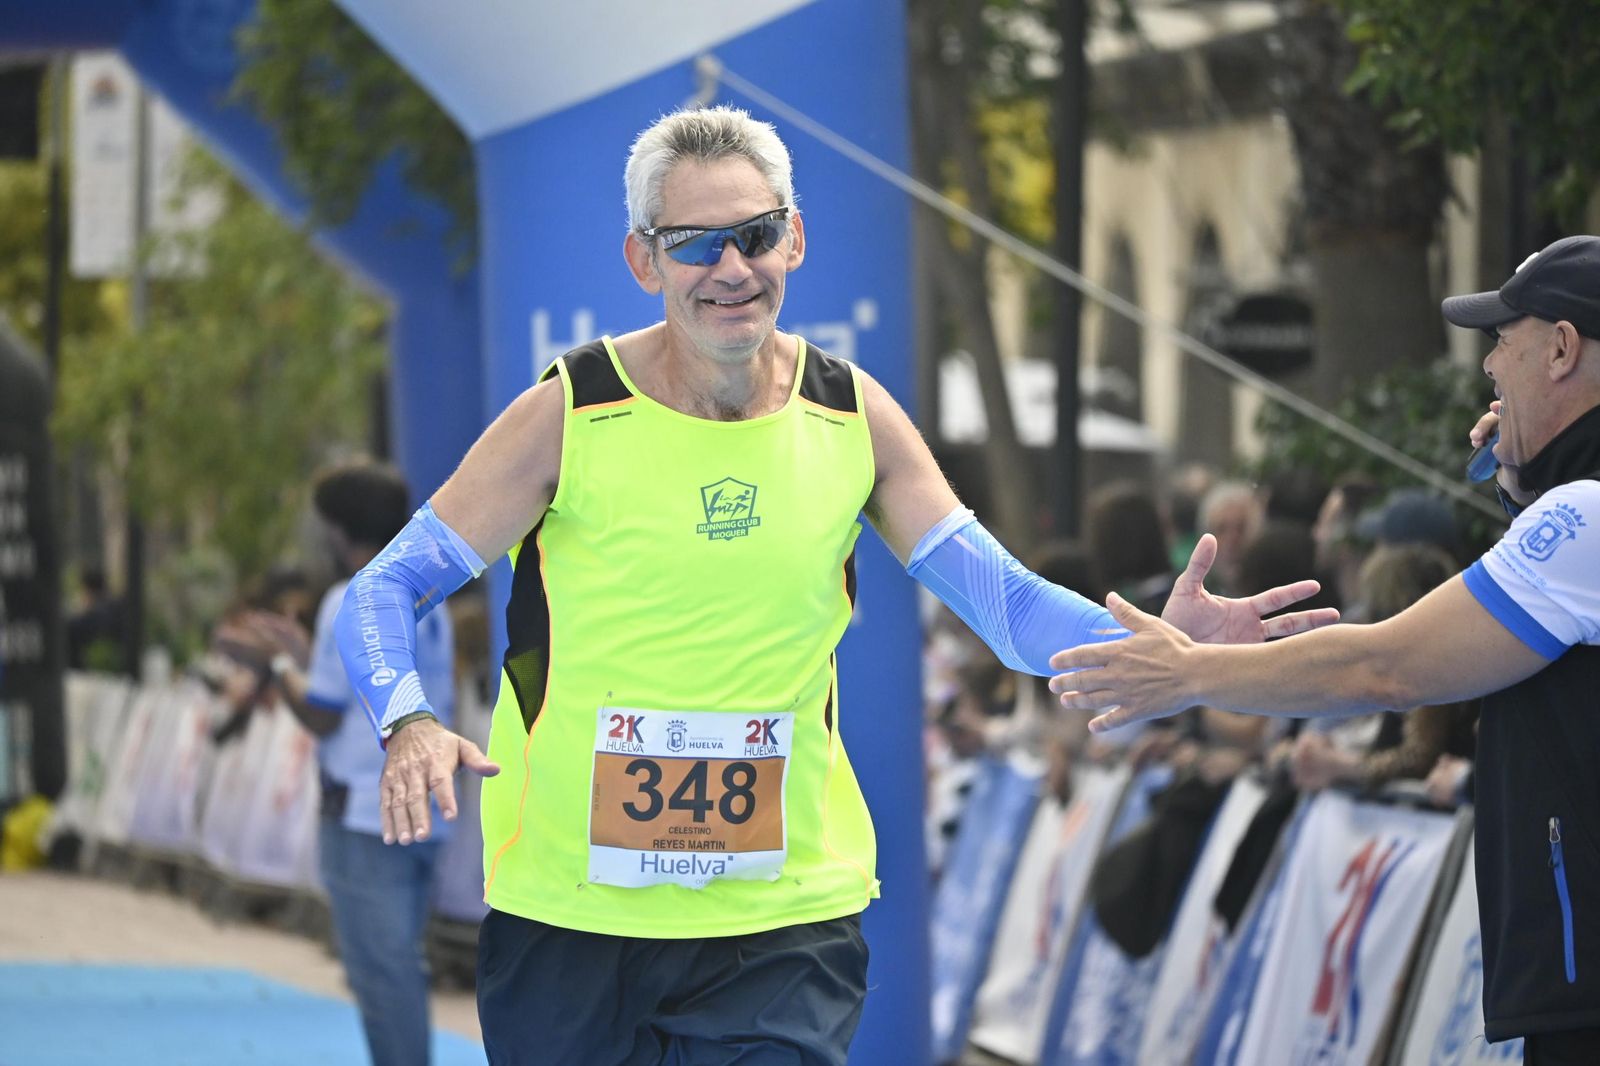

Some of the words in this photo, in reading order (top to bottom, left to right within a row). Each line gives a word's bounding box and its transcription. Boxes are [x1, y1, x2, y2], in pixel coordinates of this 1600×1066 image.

[698, 521, 736, 533] RUNNING
[737, 518, 758, 527] CLUB
[712, 529, 746, 539] MOGUER
[608, 713, 645, 744] 21K
[745, 718, 780, 745] 21K
[606, 740, 645, 753] HUELVA
[689, 741, 723, 749] HUELVA
[744, 745, 778, 756] HUELVA
[622, 758, 757, 824] 348
[668, 826, 711, 835] CELESTINO
[653, 839, 685, 849] REYES
[688, 840, 726, 850] MARTIN
[641, 853, 727, 875] Huelva
